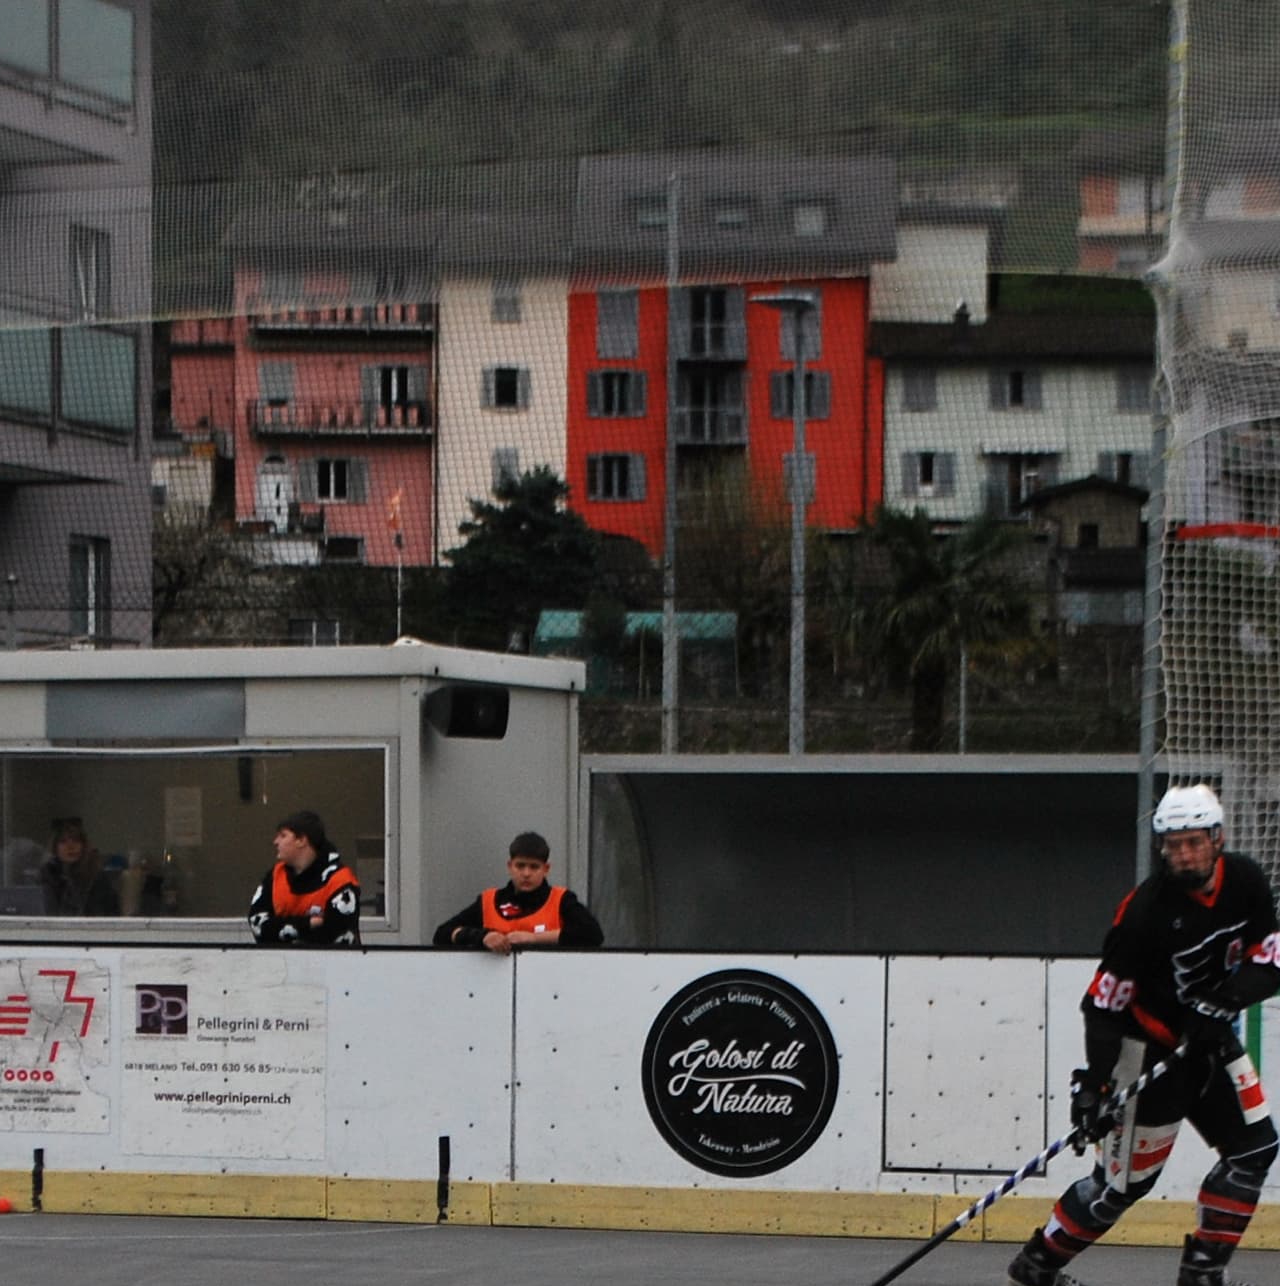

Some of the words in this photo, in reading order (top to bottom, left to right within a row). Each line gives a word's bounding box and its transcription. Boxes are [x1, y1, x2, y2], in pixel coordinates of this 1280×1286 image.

[197, 1017, 259, 1032] Pellegrini
[262, 1019, 272, 1031] &
[275, 1018, 310, 1031] Perni
[221, 1063, 241, 1073] 630
[243, 1063, 256, 1073] 56
[258, 1063, 271, 1074] 85
[668, 1038, 771, 1092] Golosi
[771, 1040, 806, 1070] di
[154, 1090, 292, 1107] www.pellegriniperni.ch
[692, 1082, 793, 1116] Natura
